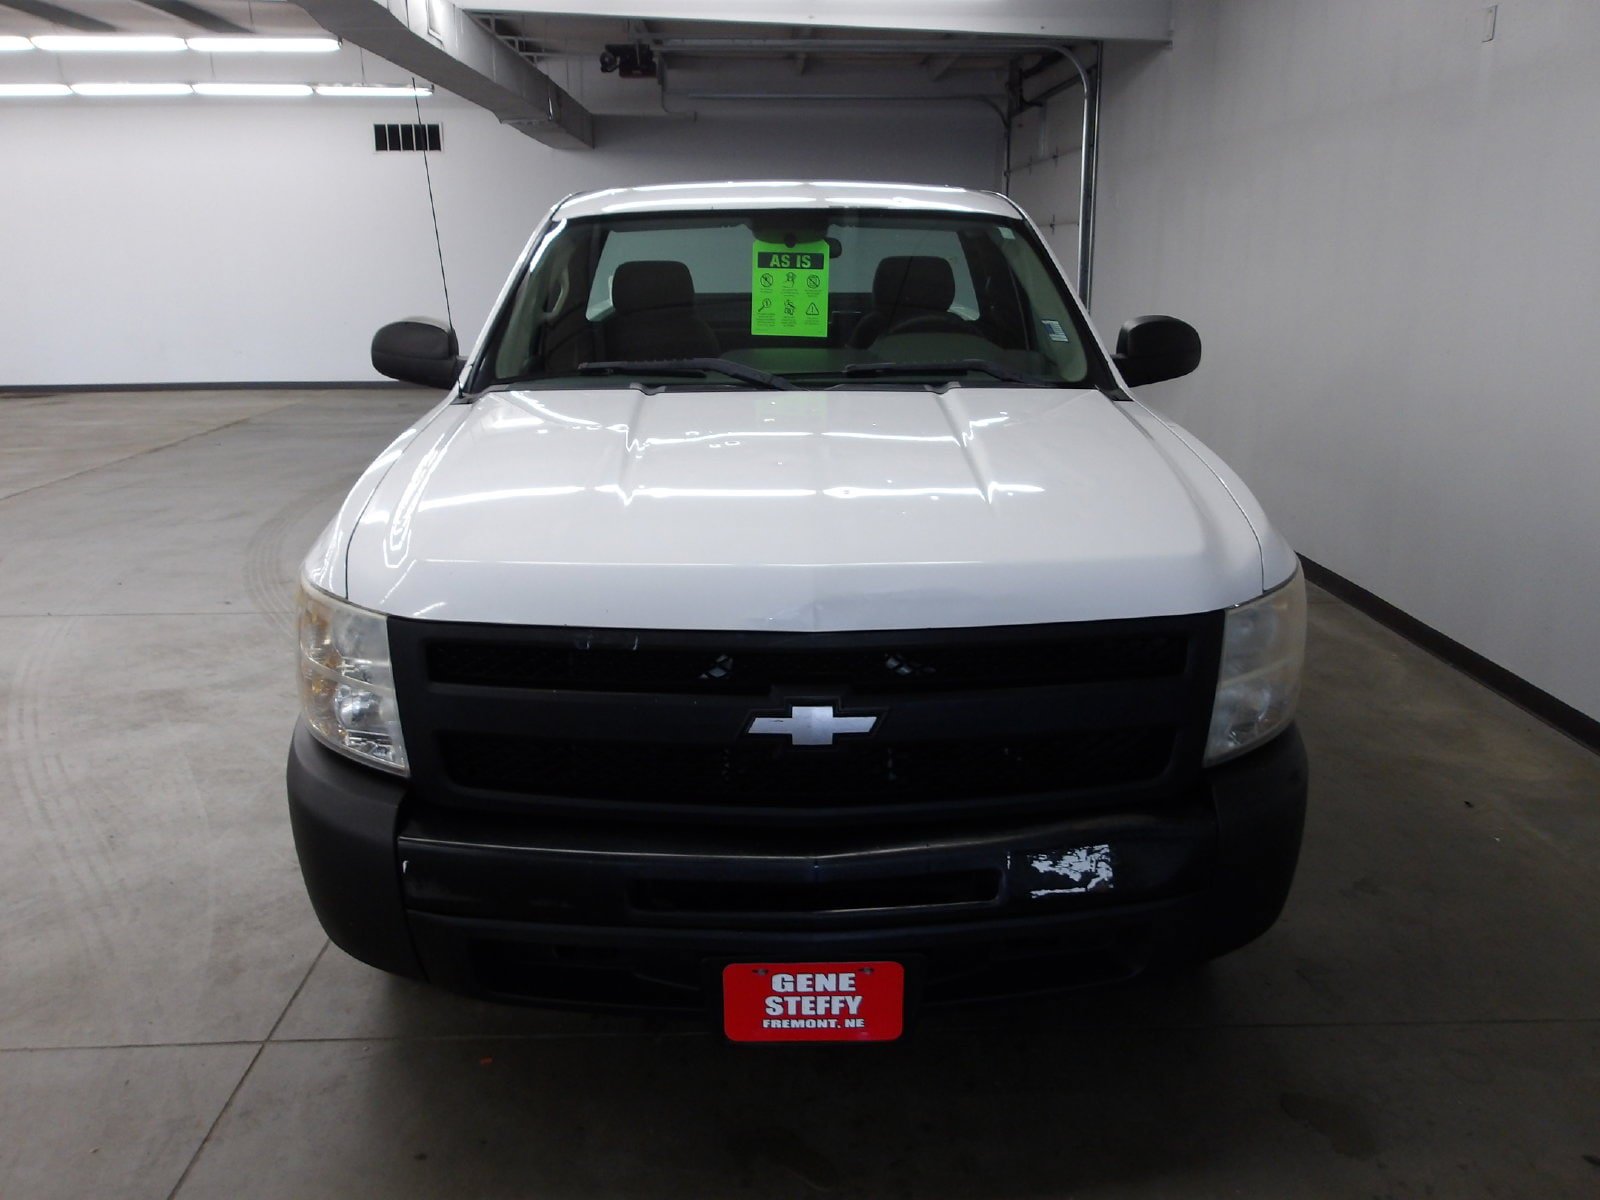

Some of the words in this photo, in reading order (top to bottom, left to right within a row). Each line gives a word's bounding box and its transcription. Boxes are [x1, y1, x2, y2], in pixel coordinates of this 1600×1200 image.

[769, 254, 790, 268] AS
[796, 255, 812, 268] IS
[771, 973, 856, 993] GENE
[764, 995, 863, 1016] STEFFY
[845, 1018, 865, 1028] NE
